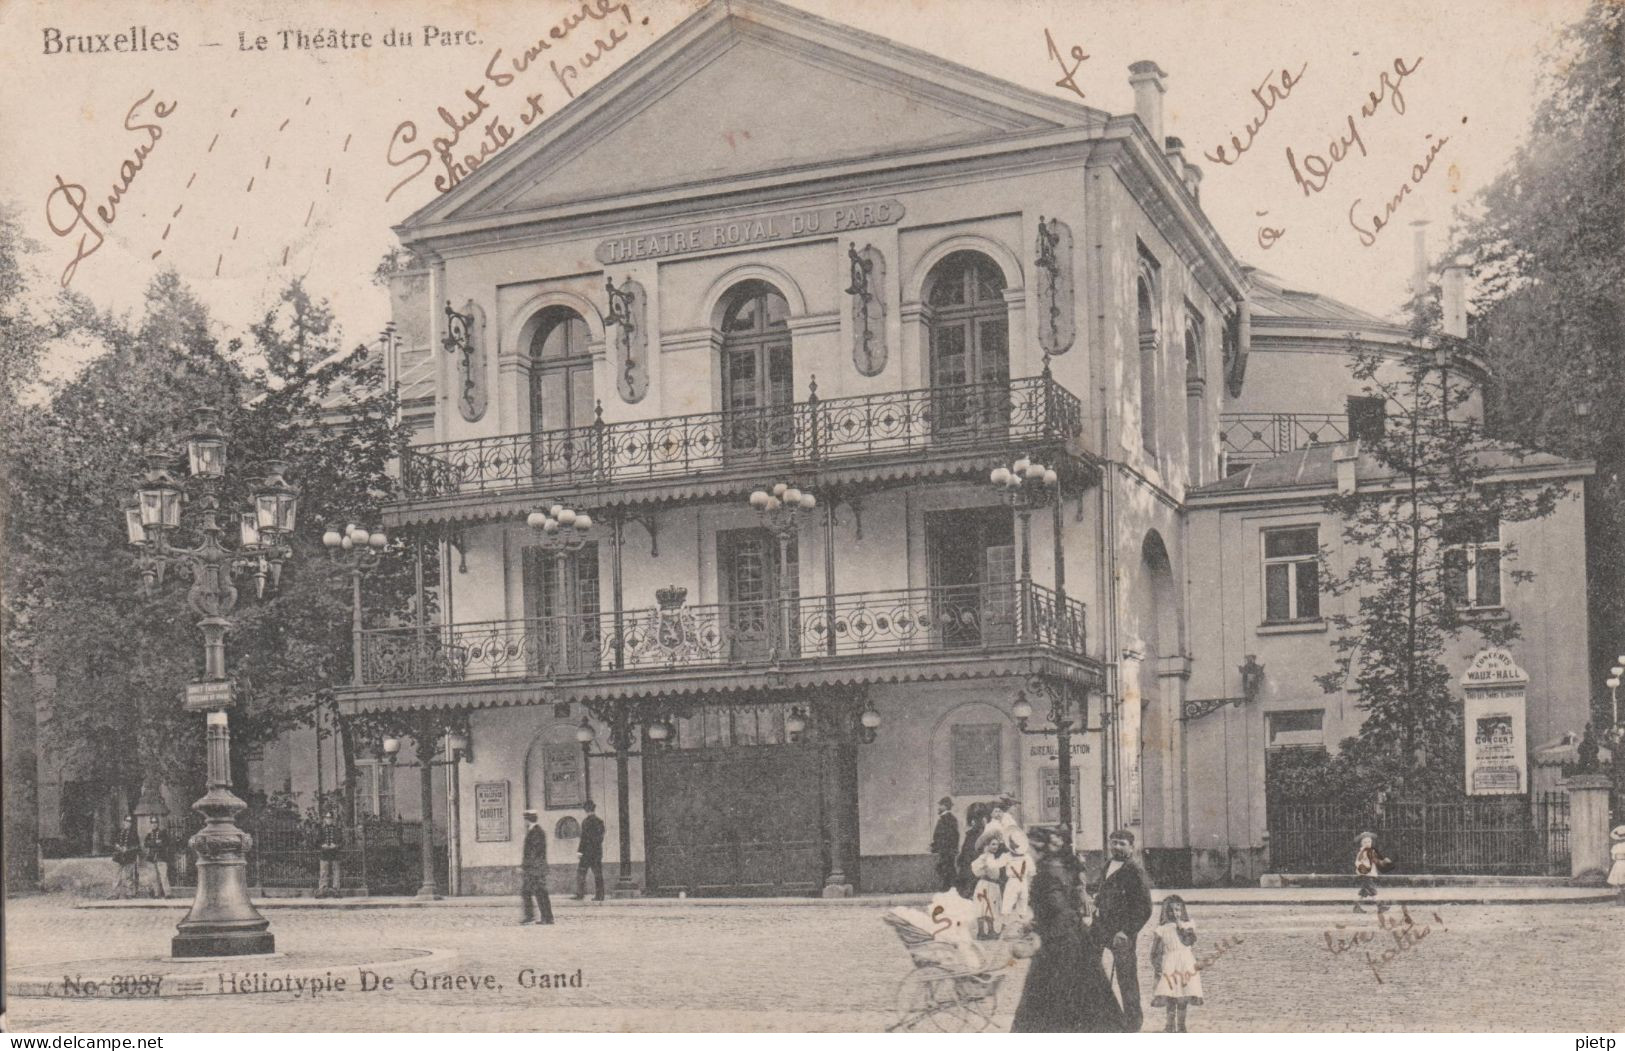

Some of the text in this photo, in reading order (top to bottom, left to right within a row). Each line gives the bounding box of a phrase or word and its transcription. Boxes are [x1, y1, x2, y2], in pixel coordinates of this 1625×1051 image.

[519, 93, 545, 125] et
[385, 85, 490, 202] Salut
[606, 203, 893, 262] THEATRE ROYAL DU PARC
[1467, 670, 1521, 681] WAUX-HALL
[1475, 736, 1514, 745] CONCERT
